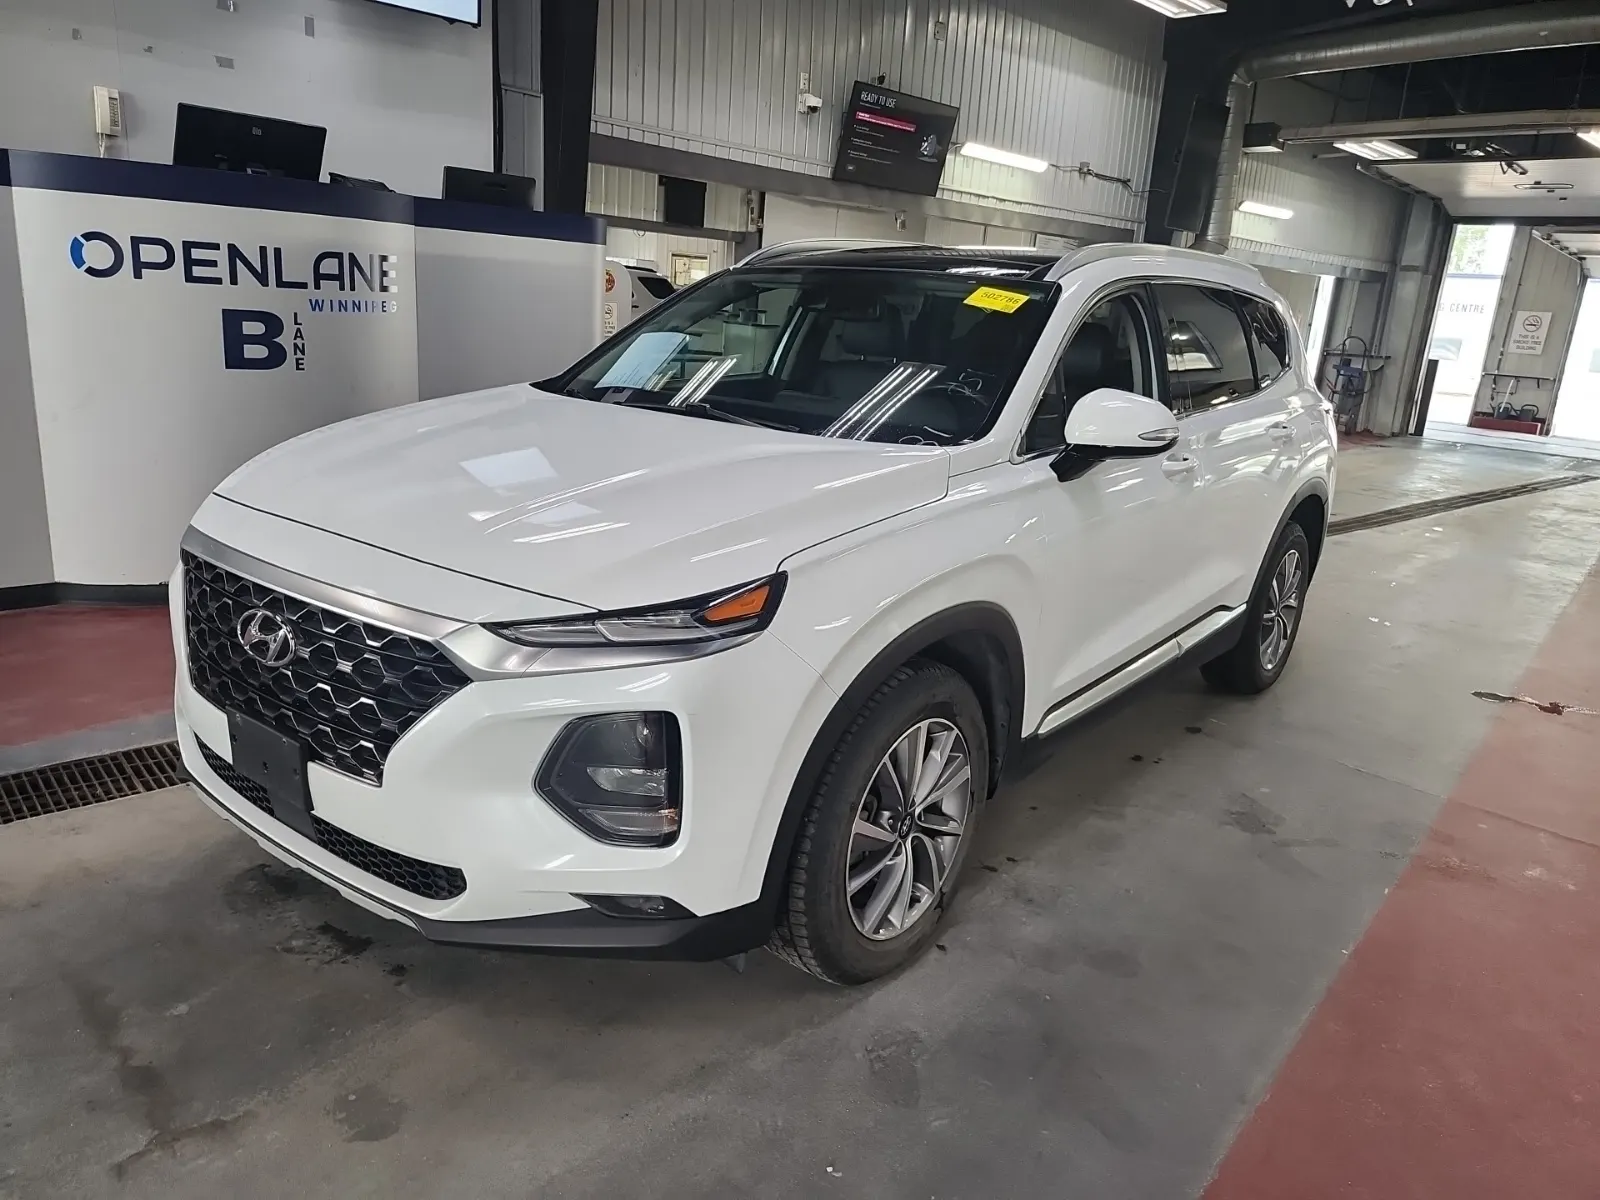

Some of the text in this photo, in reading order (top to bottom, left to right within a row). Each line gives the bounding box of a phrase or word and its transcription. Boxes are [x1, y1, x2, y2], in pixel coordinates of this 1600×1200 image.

[861, 91, 878, 103] READY
[878, 95, 885, 105] TO
[886, 97, 897, 108] USE
[69, 231, 399, 293] OPENLANE
[981, 291, 1021, 304] 502786
[308, 298, 398, 314] WINNIPEG
[1449, 303, 1485, 314] CENTRE
[221, 308, 306, 372] B LANE
